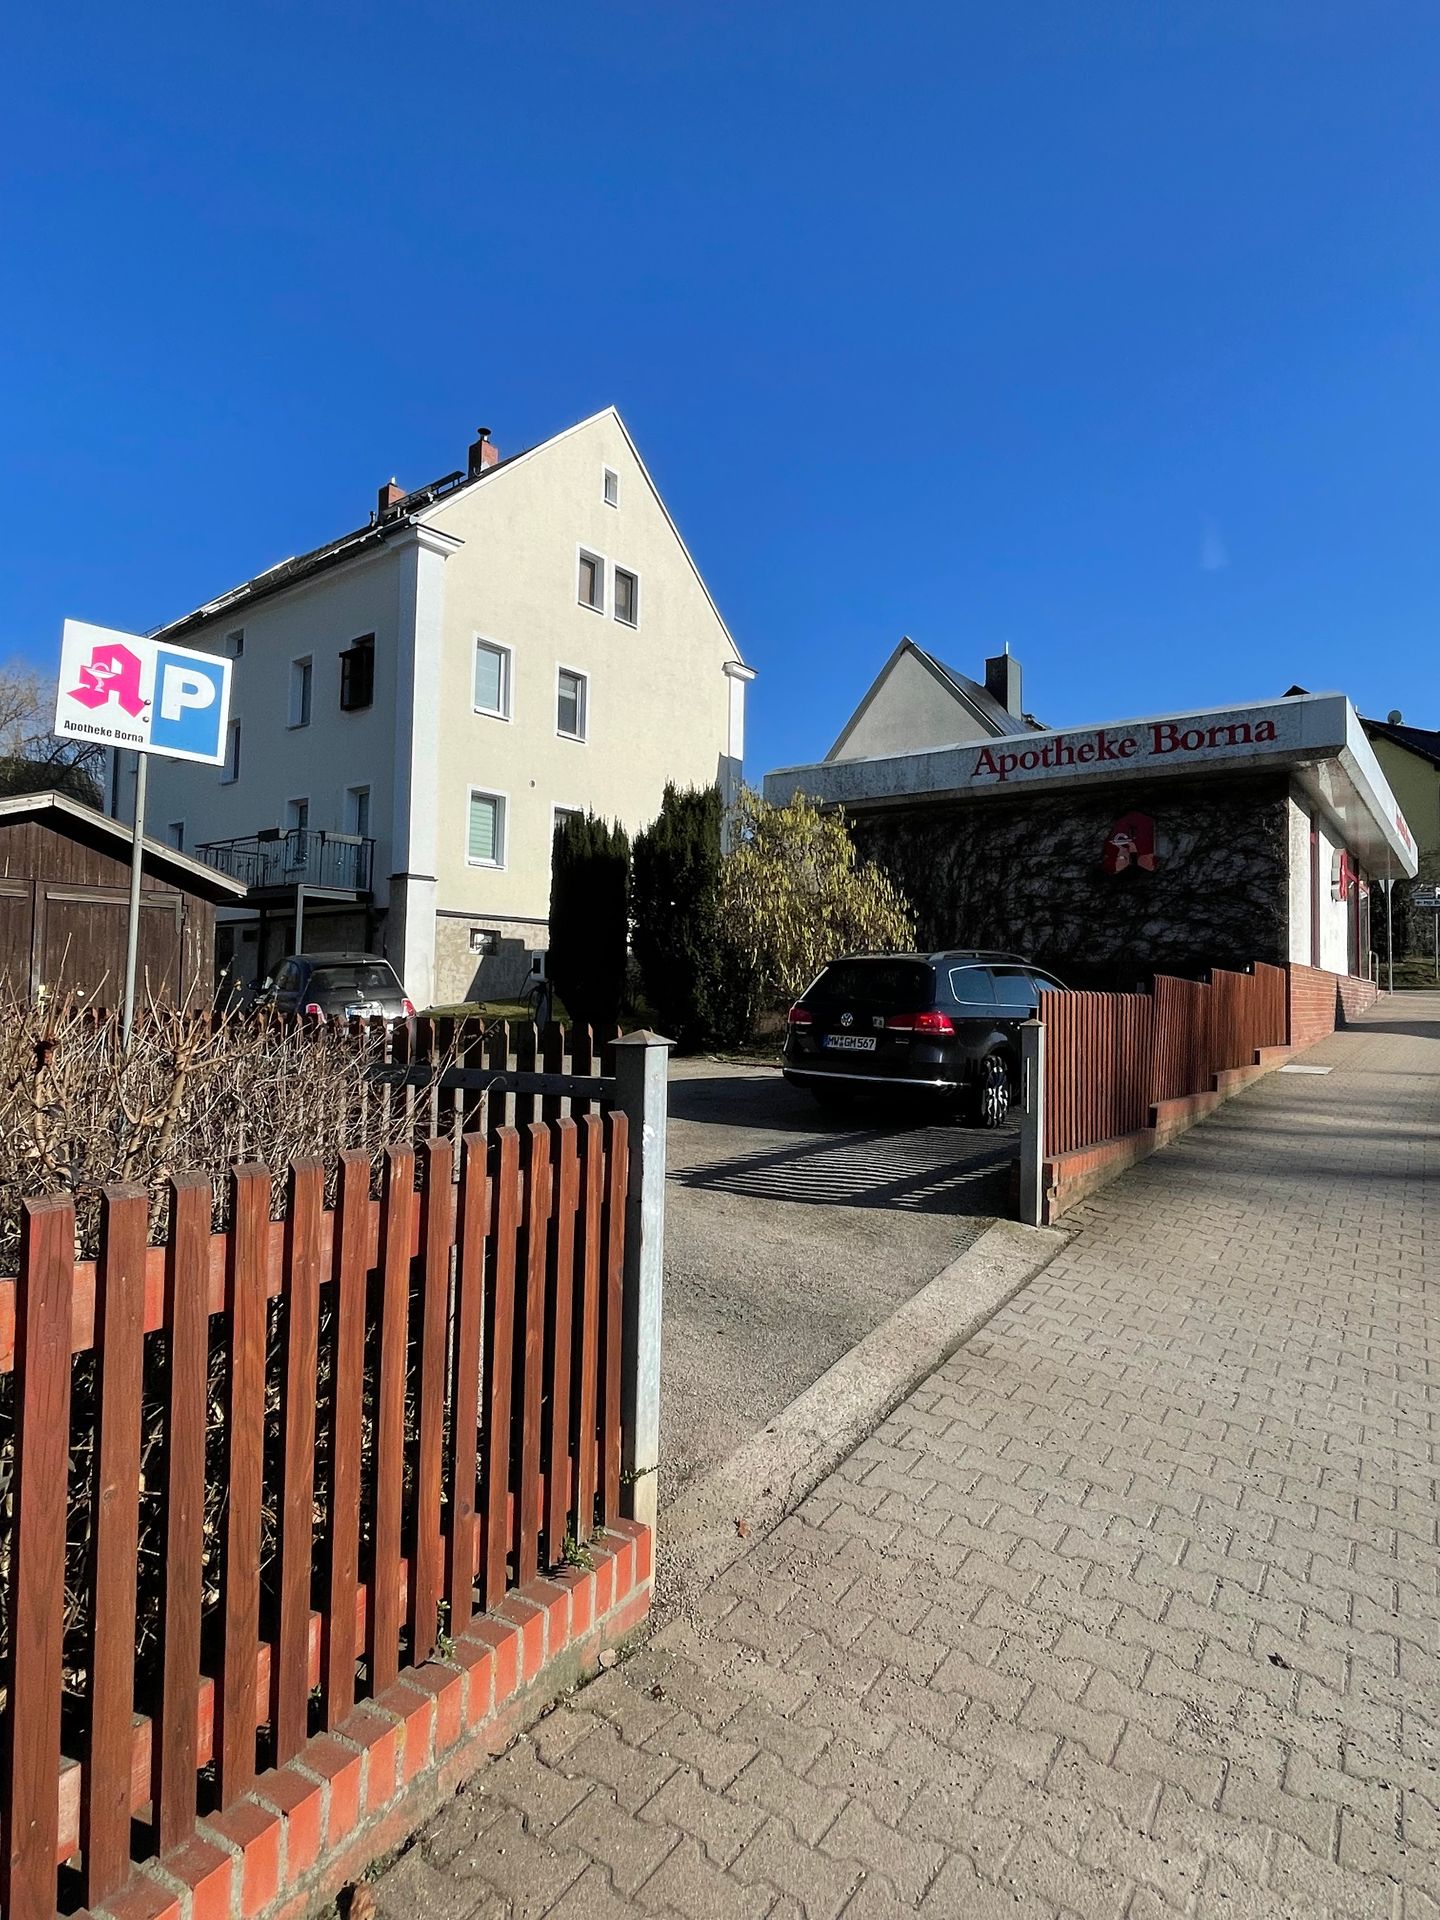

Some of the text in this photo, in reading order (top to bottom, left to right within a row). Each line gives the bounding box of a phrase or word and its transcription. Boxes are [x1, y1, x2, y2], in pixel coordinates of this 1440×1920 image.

[161, 664, 216, 721] P
[63, 719, 144, 743] Apotheke Borna
[972, 719, 1278, 781] Apotheke Borna
